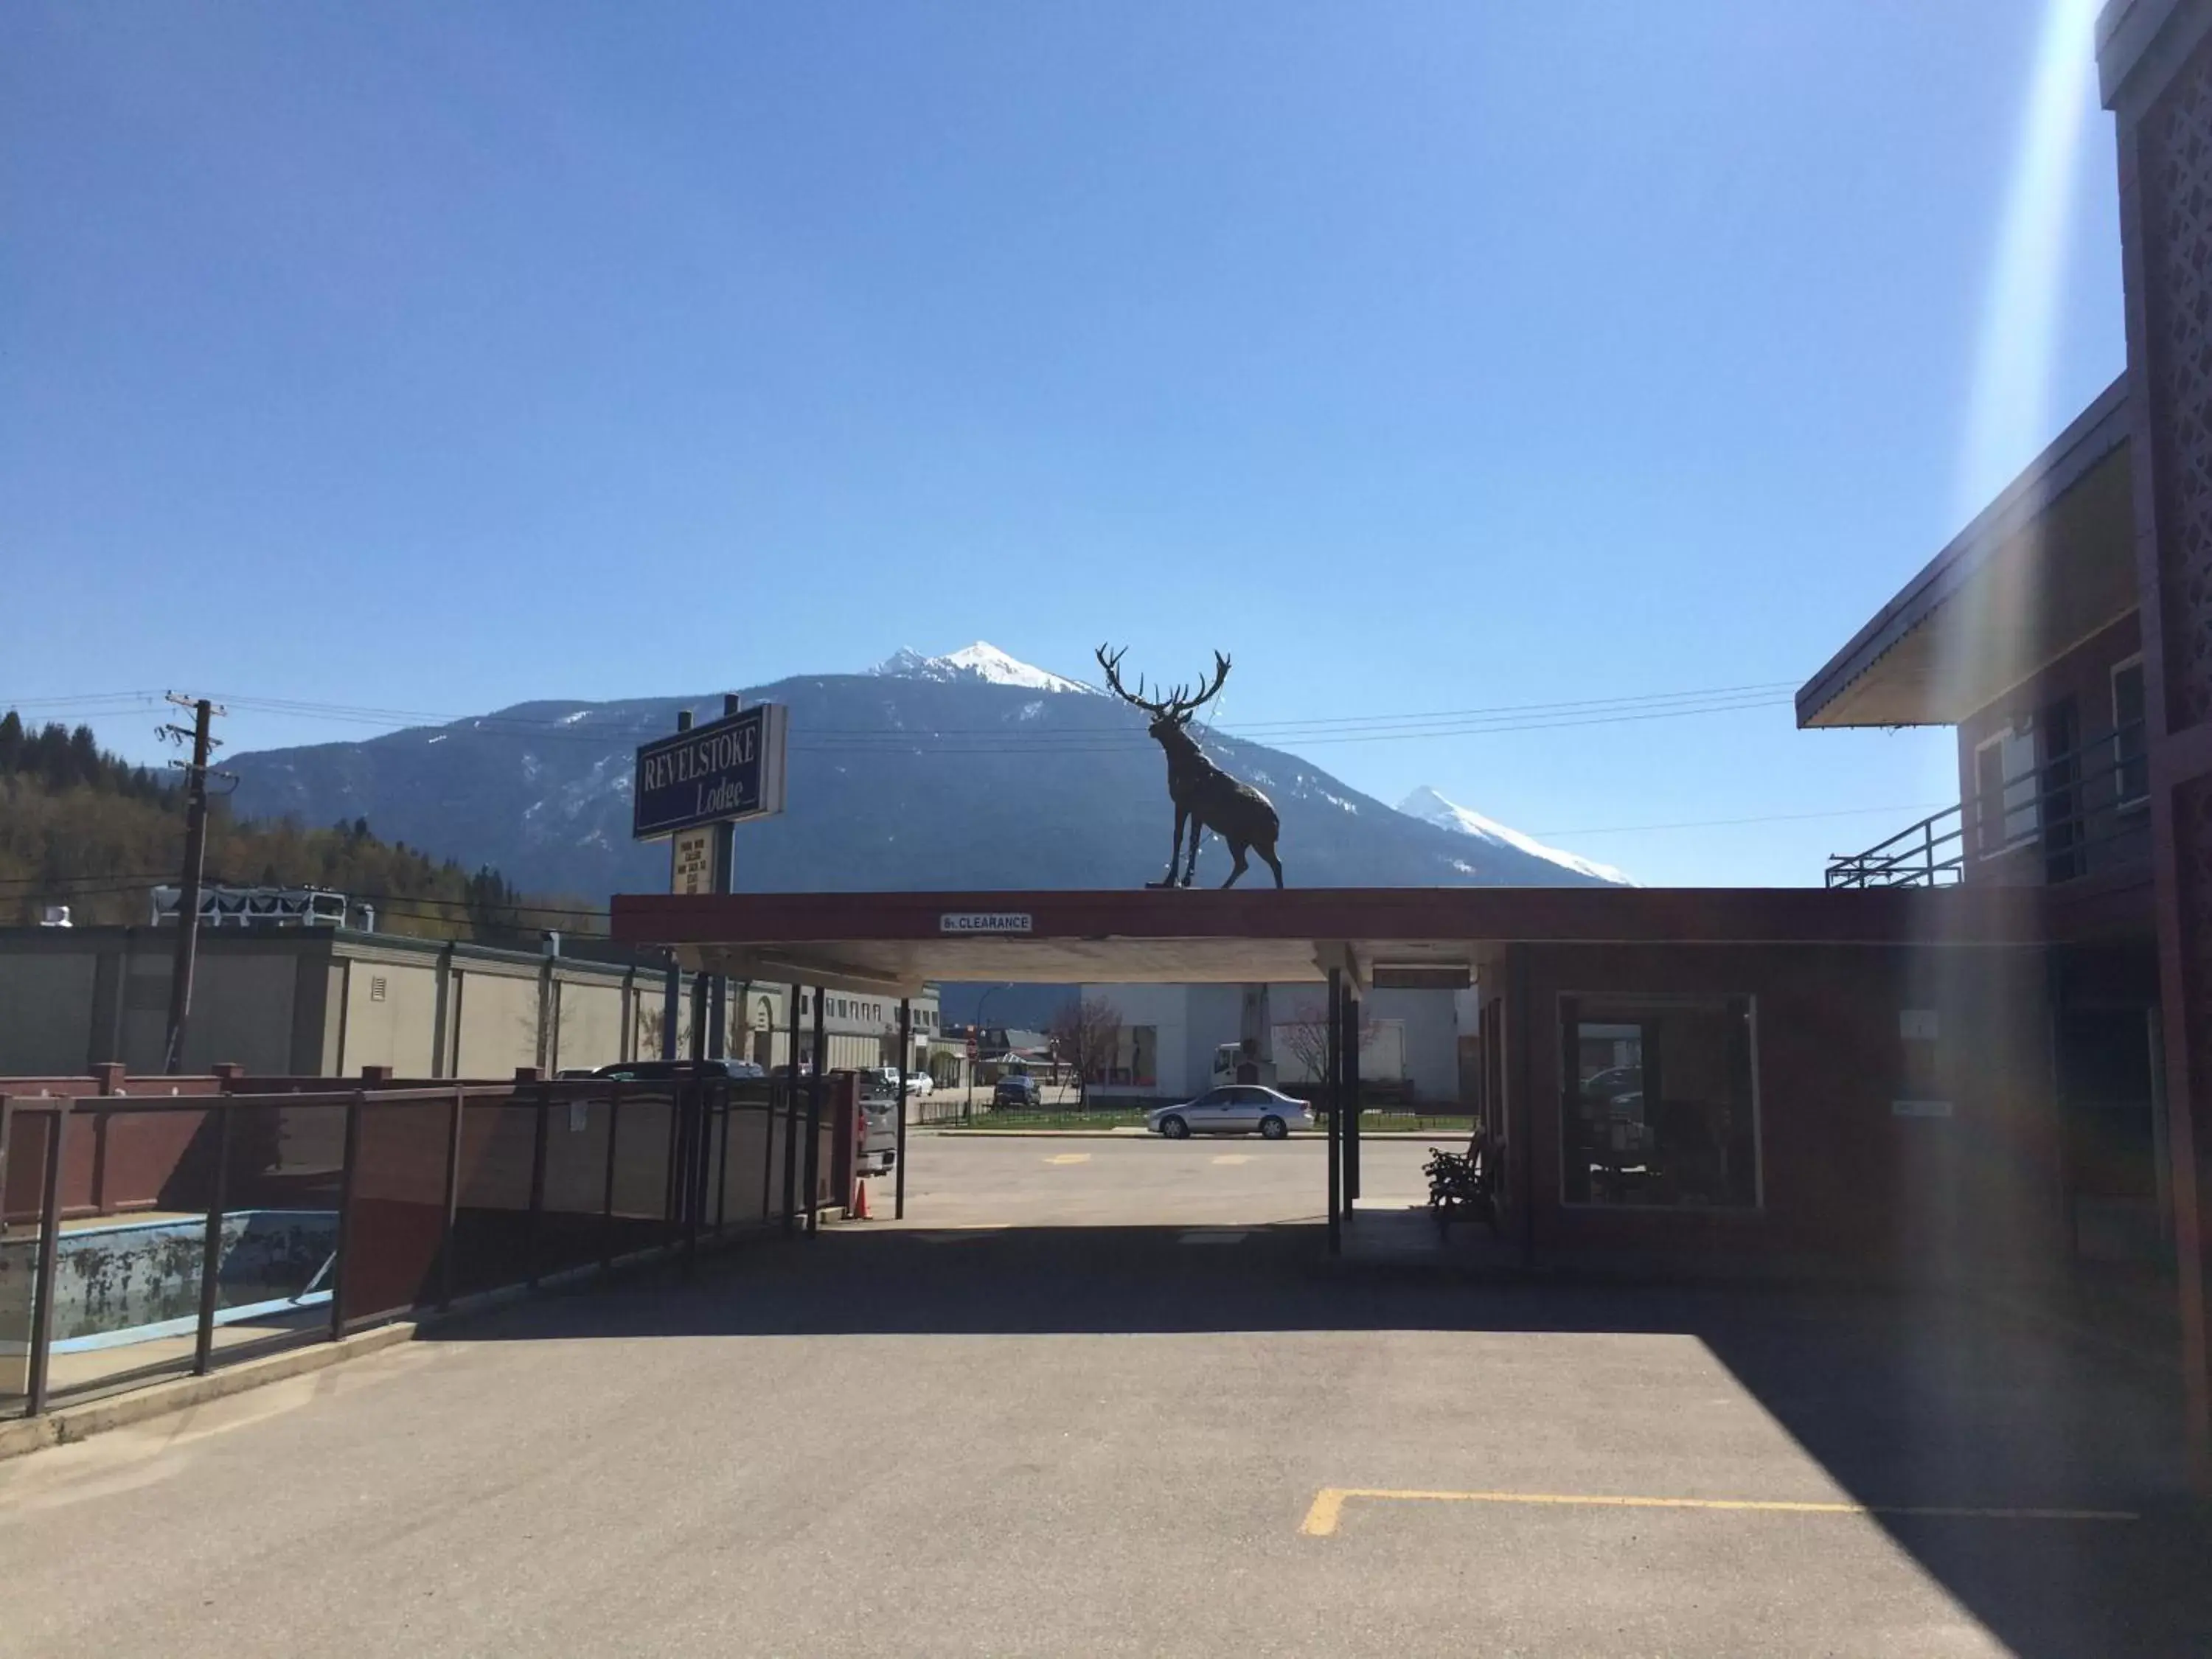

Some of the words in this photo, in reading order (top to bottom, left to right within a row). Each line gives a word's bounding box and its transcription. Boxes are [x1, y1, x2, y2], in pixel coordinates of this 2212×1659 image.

[645, 726, 756, 791] REVELSTOKE
[695, 776, 743, 815] Lodge
[959, 917, 1029, 929] CLEARANCE
